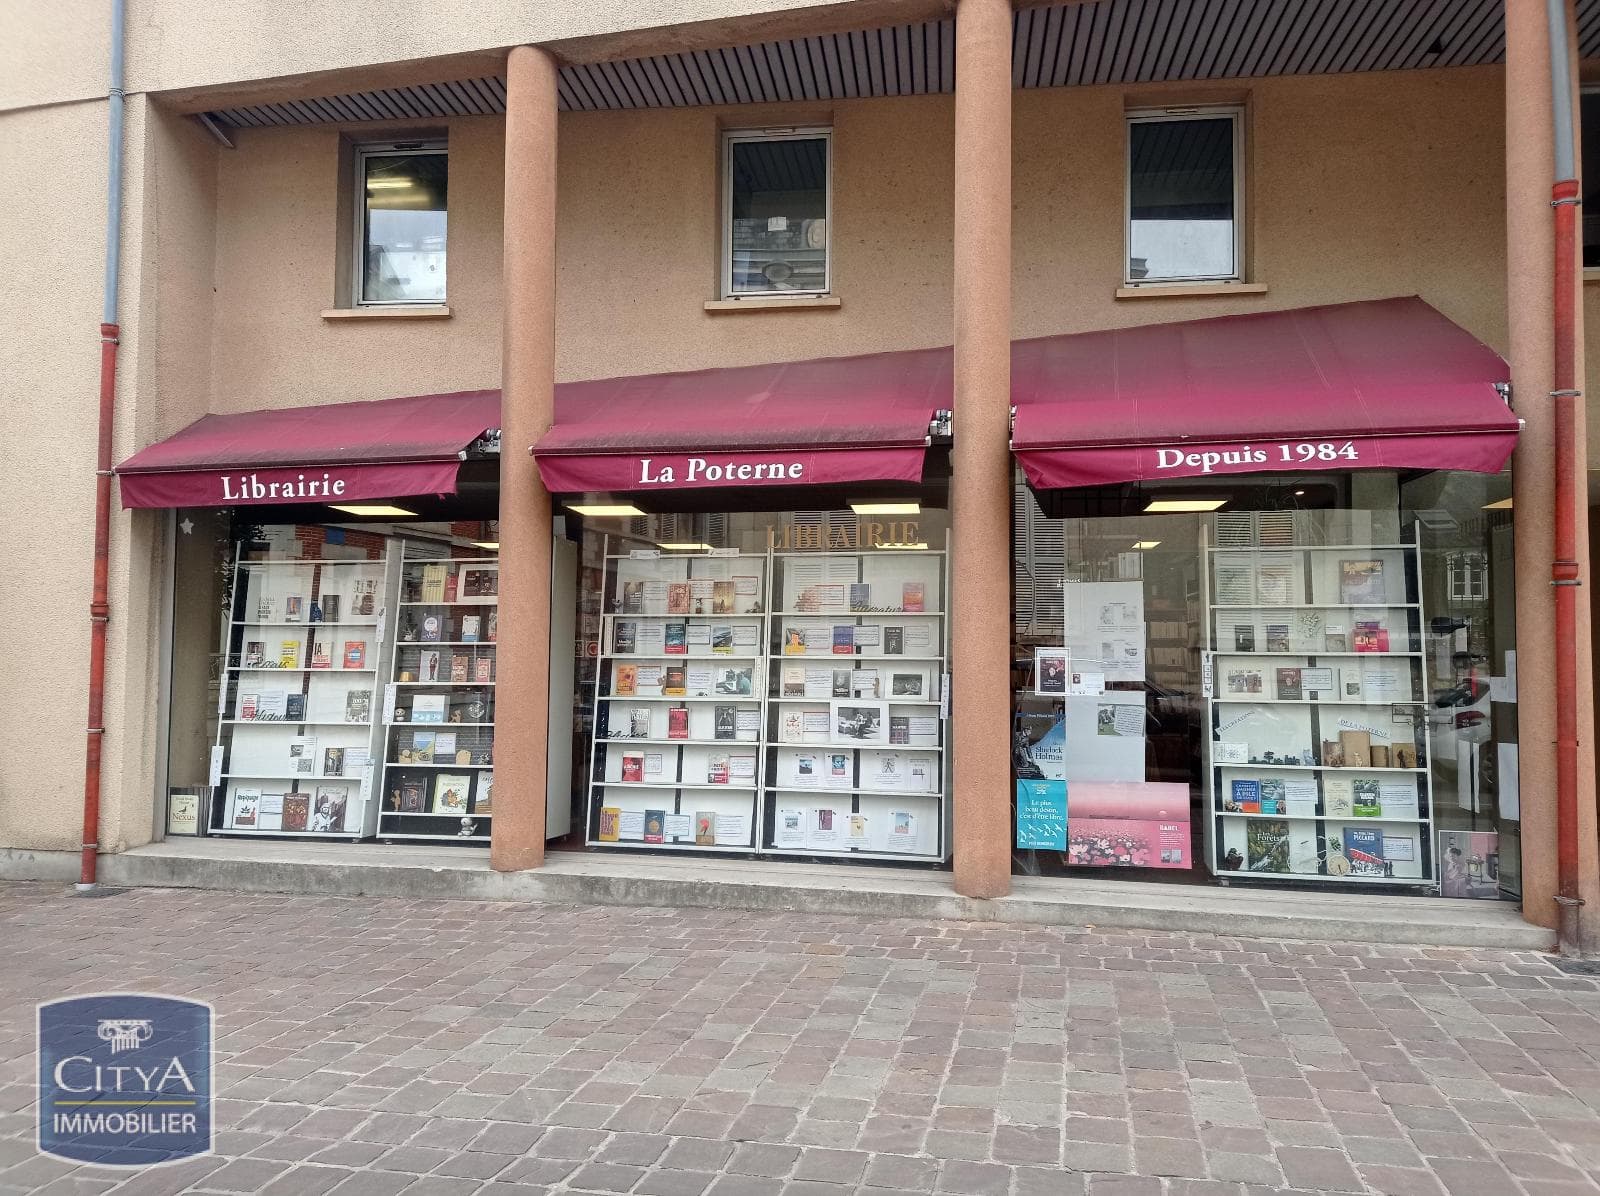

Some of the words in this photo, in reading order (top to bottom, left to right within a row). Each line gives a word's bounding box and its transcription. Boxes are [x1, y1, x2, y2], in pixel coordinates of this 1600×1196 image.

[639, 459, 675, 483] La
[685, 458, 803, 482] Poterne
[1156, 446, 1267, 473] Depuis
[1278, 441, 1359, 462] 1984
[220, 473, 345, 500] Librairie
[766, 521, 920, 549] LIBRAIRIE
[172, 812, 195, 821] Nexus
